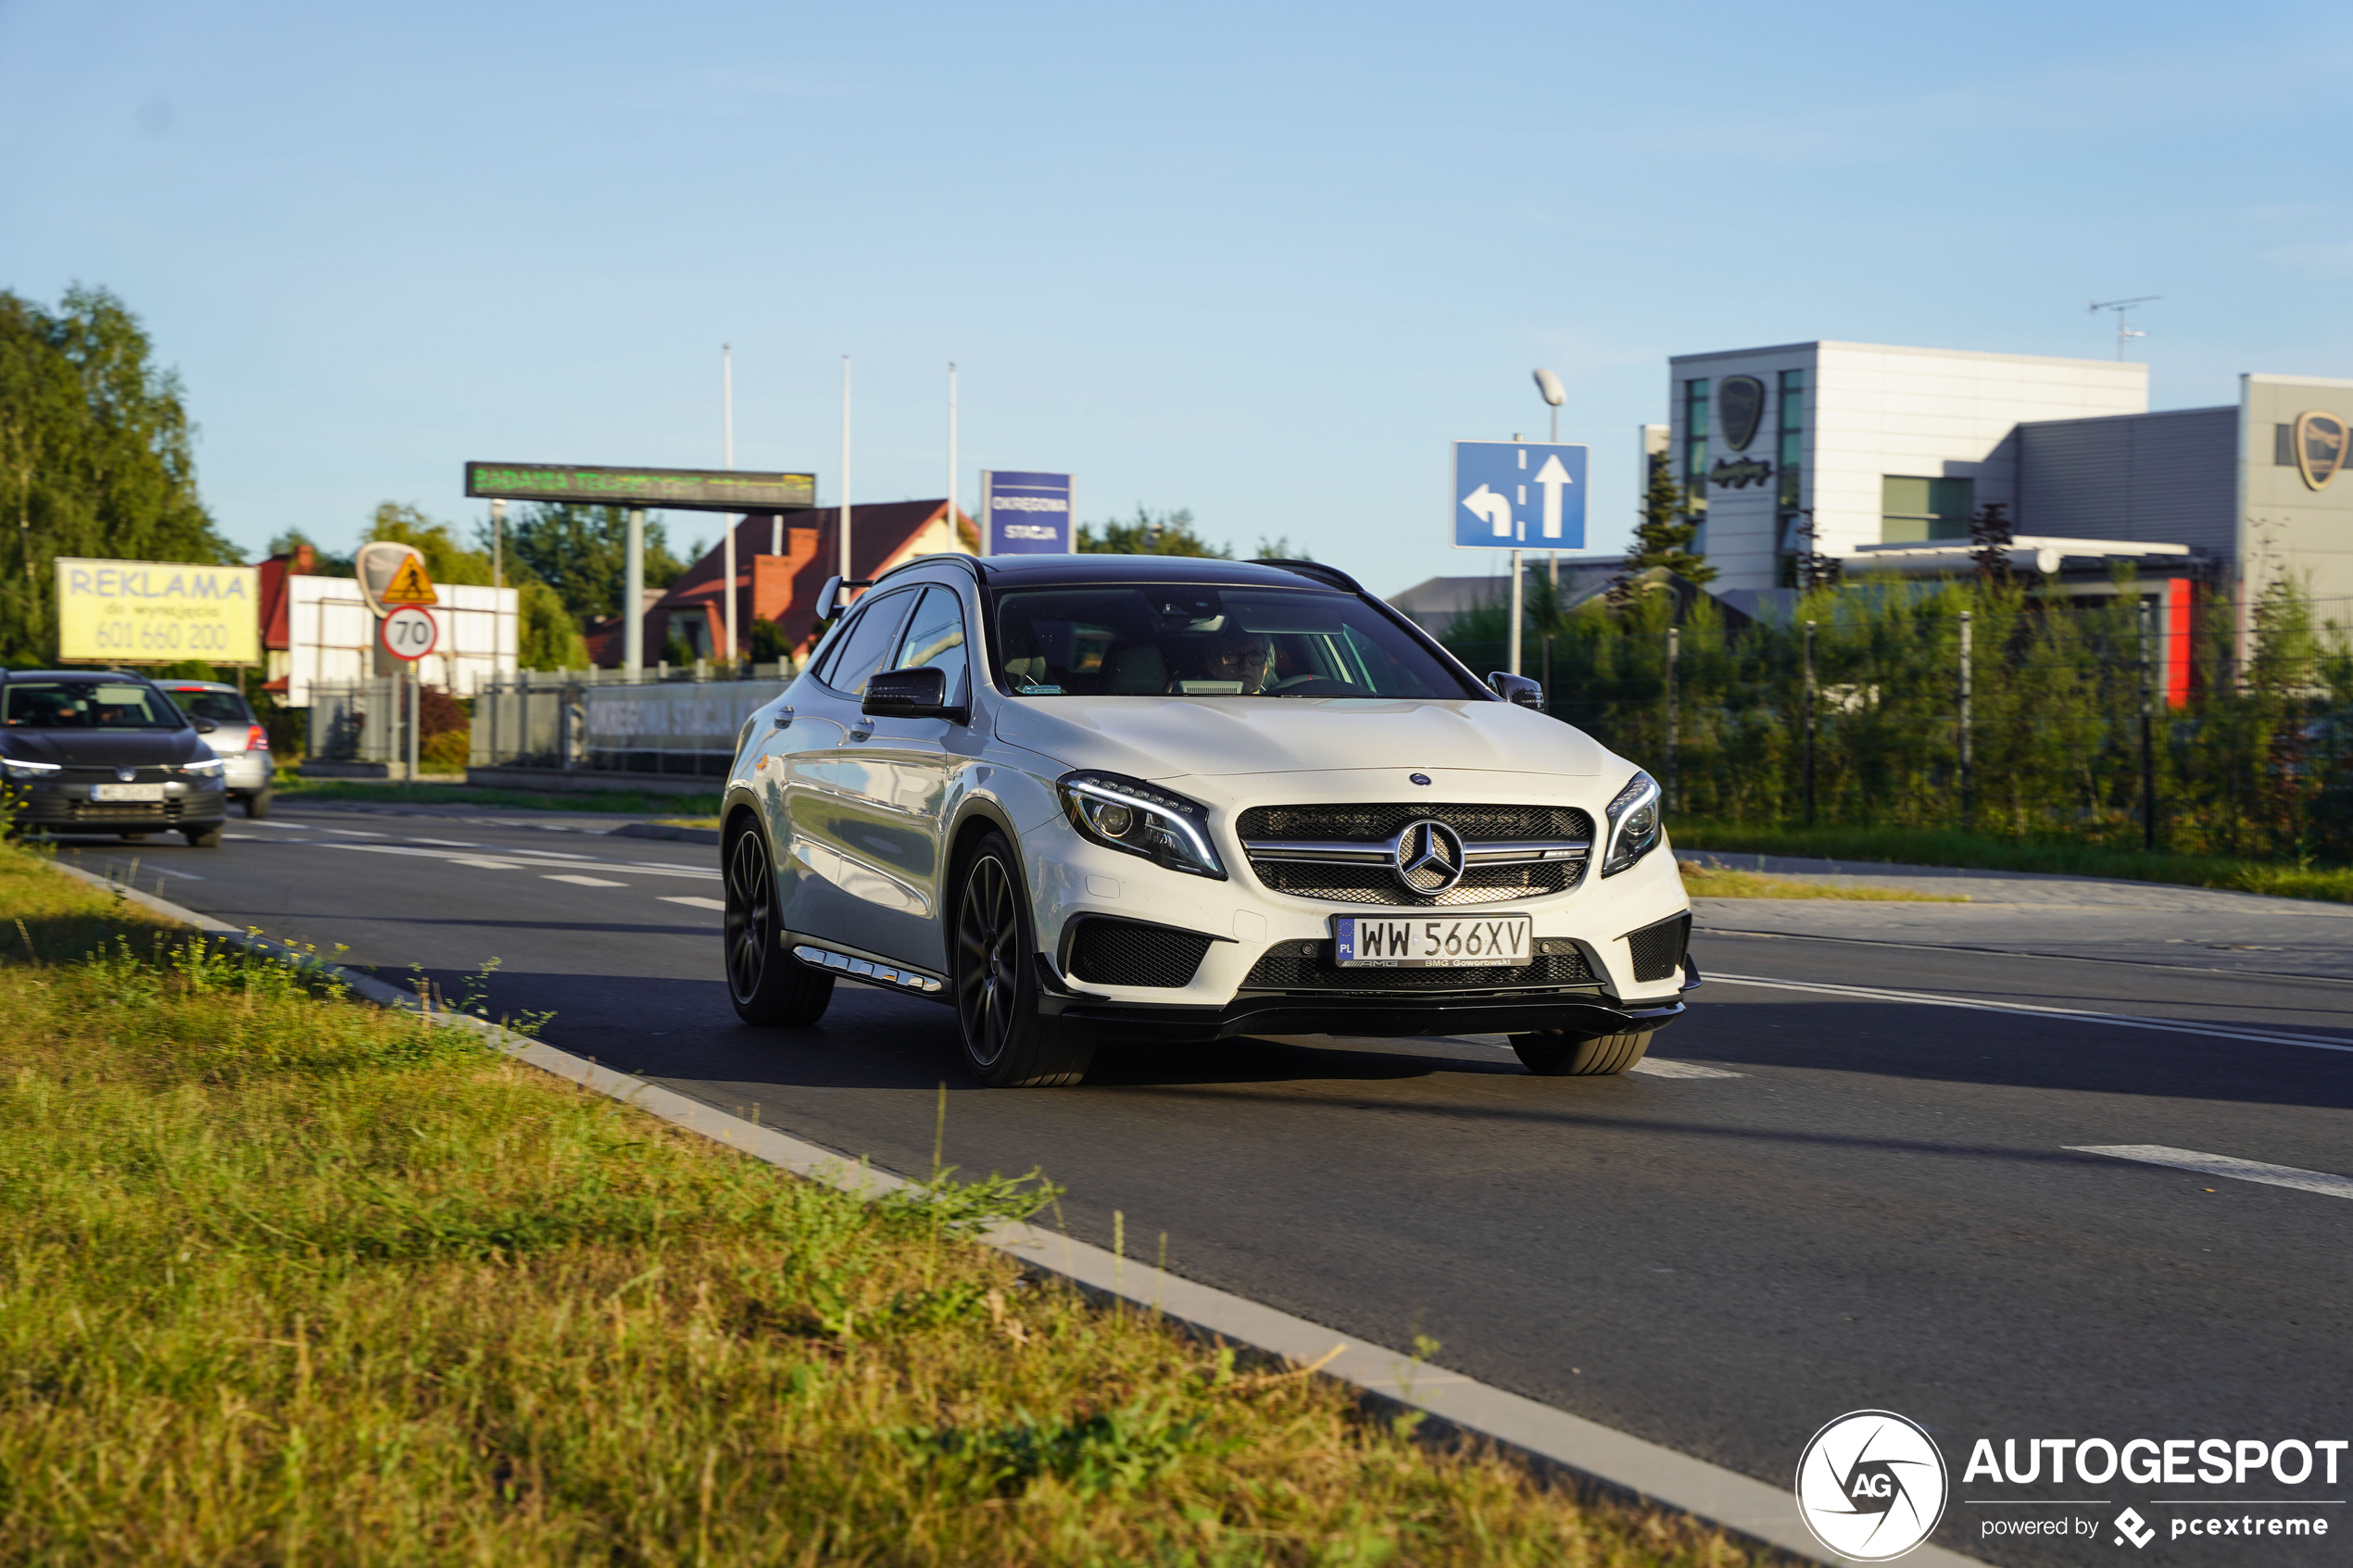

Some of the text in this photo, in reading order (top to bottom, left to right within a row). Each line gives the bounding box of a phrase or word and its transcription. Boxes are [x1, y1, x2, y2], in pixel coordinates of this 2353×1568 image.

[1004, 524, 1057, 540] STACJA
[70, 569, 245, 599] REKLAMA
[105, 603, 126, 615] do
[96, 621, 228, 650] 601 660 200
[395, 621, 428, 645] 70
[1361, 922, 1526, 957] WW 566XV
[1340, 944, 1353, 954] PL
[1361, 960, 1399, 968] AMG
[1425, 958, 1511, 968] BMG Goworowski
